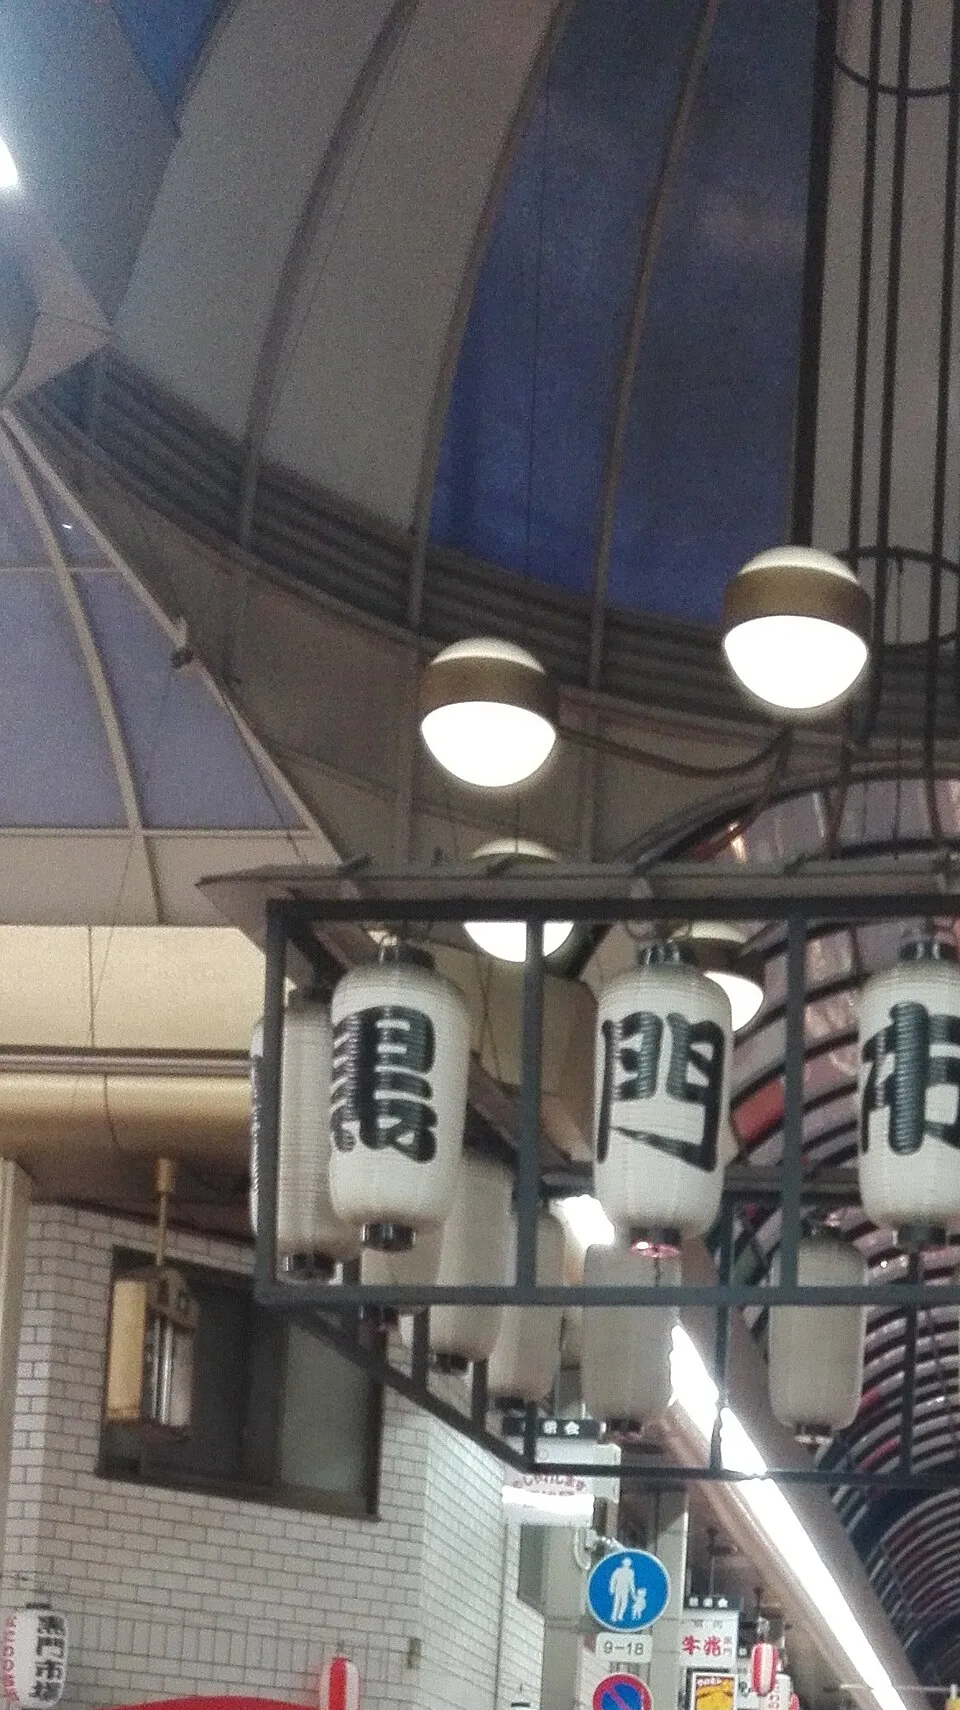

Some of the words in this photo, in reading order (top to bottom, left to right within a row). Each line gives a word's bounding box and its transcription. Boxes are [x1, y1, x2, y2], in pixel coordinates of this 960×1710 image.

[30, 1615, 66, 1702] 黒門市場
[603, 1640, 645, 1656] 9-18
